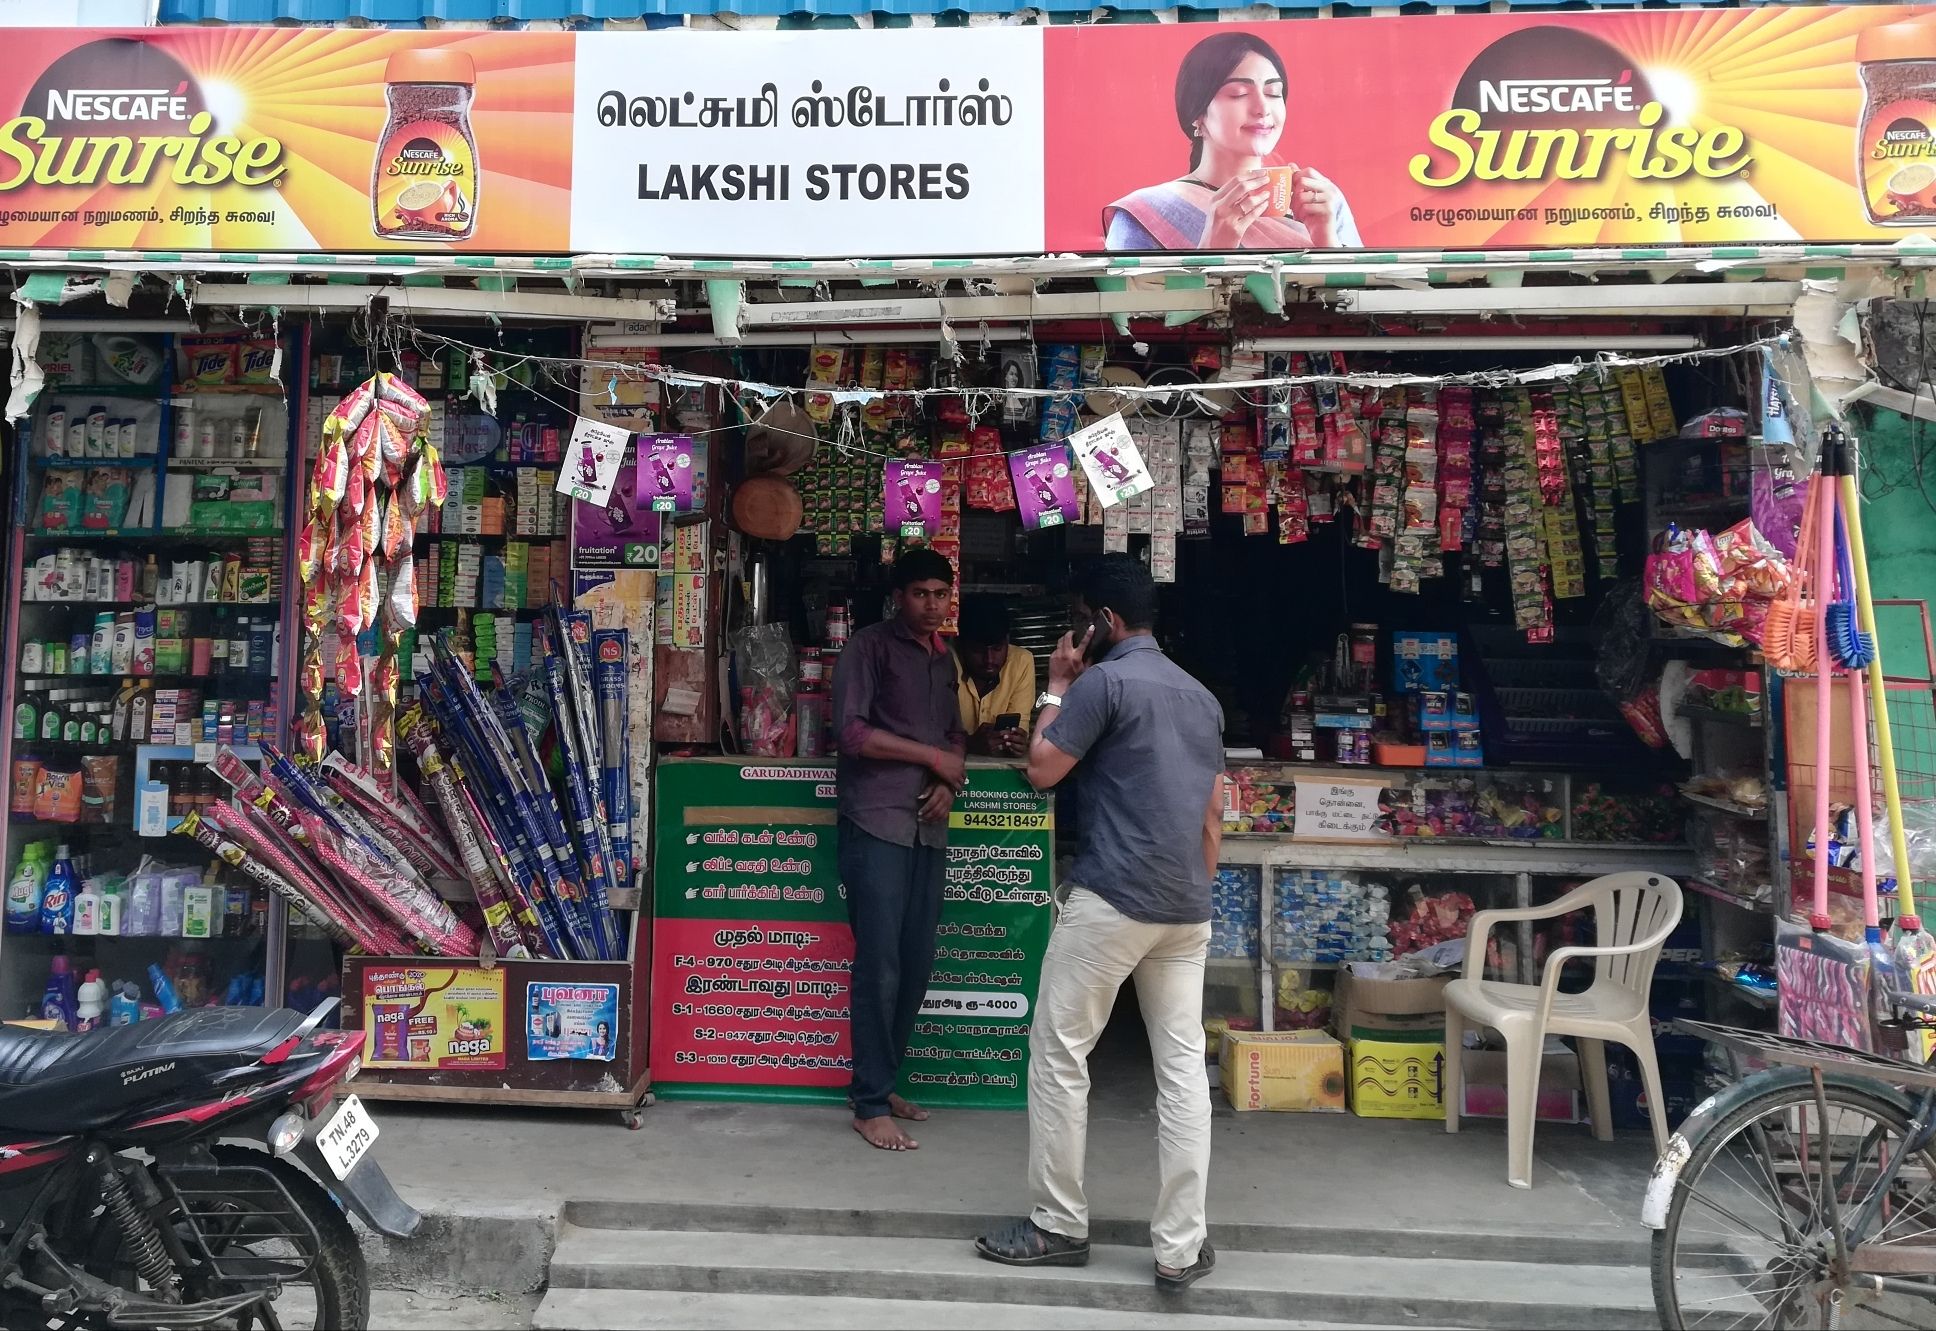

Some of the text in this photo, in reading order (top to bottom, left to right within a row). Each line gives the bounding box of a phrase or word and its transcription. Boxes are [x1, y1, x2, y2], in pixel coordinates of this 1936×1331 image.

[1480, 70, 1641, 113] NESCAFÉ
[47, 81, 191, 121] NESCAFÉ
[598, 77, 1014, 129] லெட்சுமி ஸ்டோர்ஸ்
[0, 112, 288, 191] Sunrise
[1409, 101, 1754, 189] Sunrise
[386, 157, 464, 176] Sunrise
[637, 162, 970, 201] LAKSHI STORES
[83, 206, 164, 226] நறுமணம்,
[169, 206, 220, 225] சிறந்த
[225, 207, 275, 225] சுவை!
[1410, 202, 1778, 228] செழுமையான நறுமணம், சிறந்த சுவை!
[196, 354, 228, 376] Tide
[578, 546, 615, 554] fruitation
[626, 545, 658, 562] ₹20
[603, 647, 617, 655] NS
[46, 772, 70, 782] Bourn
[49, 779, 66, 789] Vita
[970, 791, 1008, 799] BOOKING
[964, 802, 1037, 810] LAKSHMI STORES
[963, 814, 1046, 827] 9443218497
[703, 829, 817, 847] வங்கி கடன் உண்டு
[990, 844, 1042, 860] கோவில்
[735, 859, 768, 873] வசதி
[770, 858, 812, 875] உண்டு
[44, 892, 68, 909] Rin
[703, 884, 726, 900] கார்
[783, 885, 825, 903] உண்டு
[967, 885, 1052, 906] வீடு உள்ளது.
[715, 926, 763, 948] முதல்
[961, 923, 1007, 938] இருந்து
[675, 956, 695, 967] F-4
[706, 957, 733, 968] 970
[735, 958, 760, 971] சதுர
[685, 974, 791, 998] இரண்டாவது
[542, 986, 610, 1006] புவனா
[377, 1011, 405, 1024] naga
[672, 1004, 693, 1015] S-1
[703, 1005, 733, 1016] 1660
[735, 1006, 761, 1019] சதுர
[408, 1016, 435, 1026] FREE
[694, 1028, 716, 1040] S-2
[726, 1031, 747, 1040] 947
[747, 1031, 773, 1044] சதுர
[448, 1039, 490, 1056] naga
[675, 1052, 697, 1063] S-3
[730, 1055, 756, 1069] சதுர
[123, 1062, 176, 1087] PLATINA
[1247, 1051, 1261, 1111] Fortune
[338, 1128, 371, 1170] L.3279
